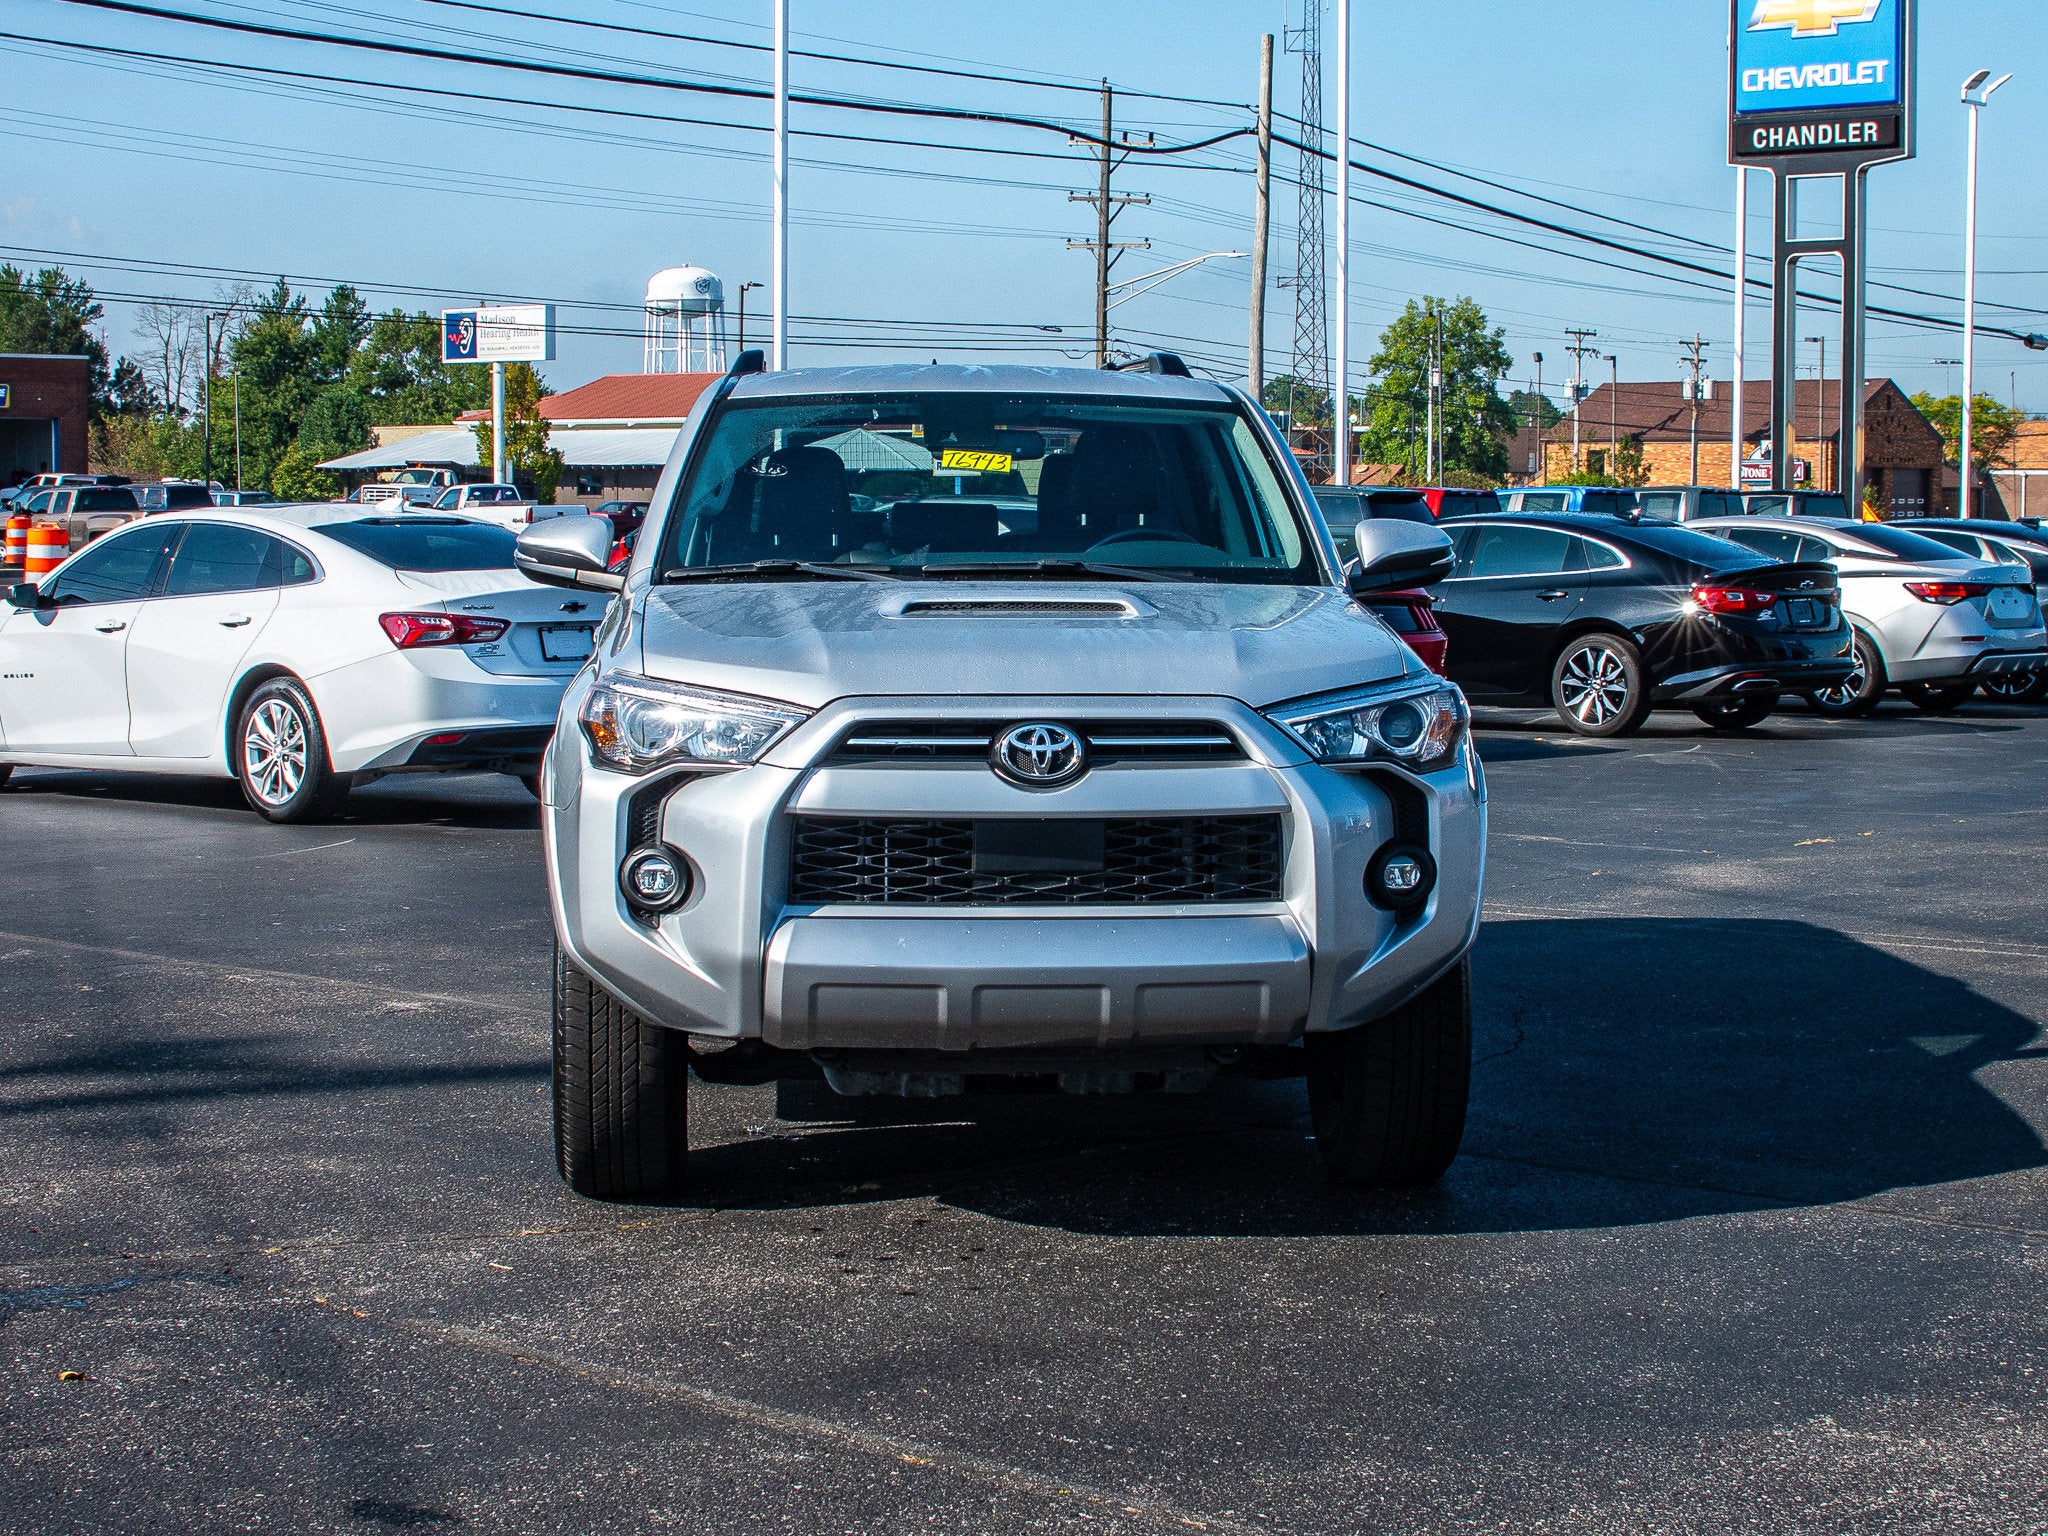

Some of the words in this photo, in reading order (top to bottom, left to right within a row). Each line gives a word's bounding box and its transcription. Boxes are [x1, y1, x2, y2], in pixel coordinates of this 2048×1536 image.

[1742, 60, 1889, 92] CHEVROLET
[1752, 121, 1879, 149] CHANDLER
[480, 315, 516, 325] Madison
[480, 329, 511, 340] Hearing
[945, 452, 1008, 471] T6943
